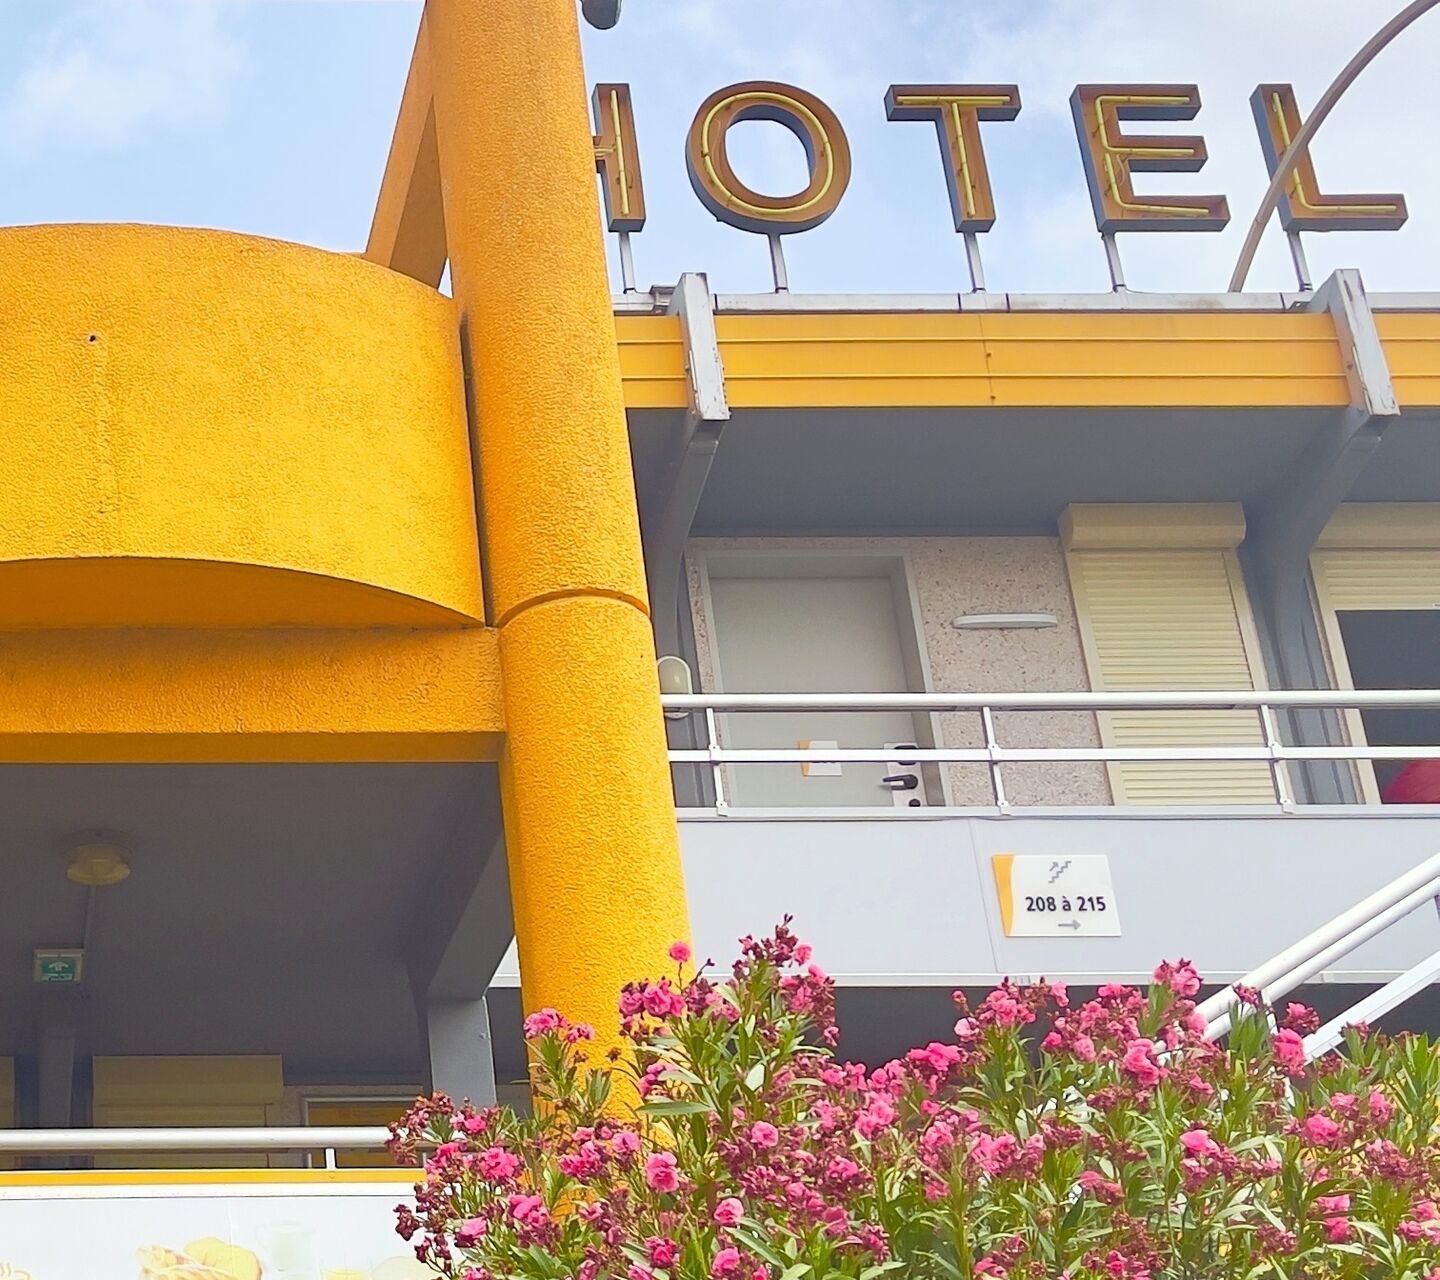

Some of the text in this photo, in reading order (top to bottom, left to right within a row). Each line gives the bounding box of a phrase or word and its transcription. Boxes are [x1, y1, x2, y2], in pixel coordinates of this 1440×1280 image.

[1025, 895, 1106, 912] 208 à 215
